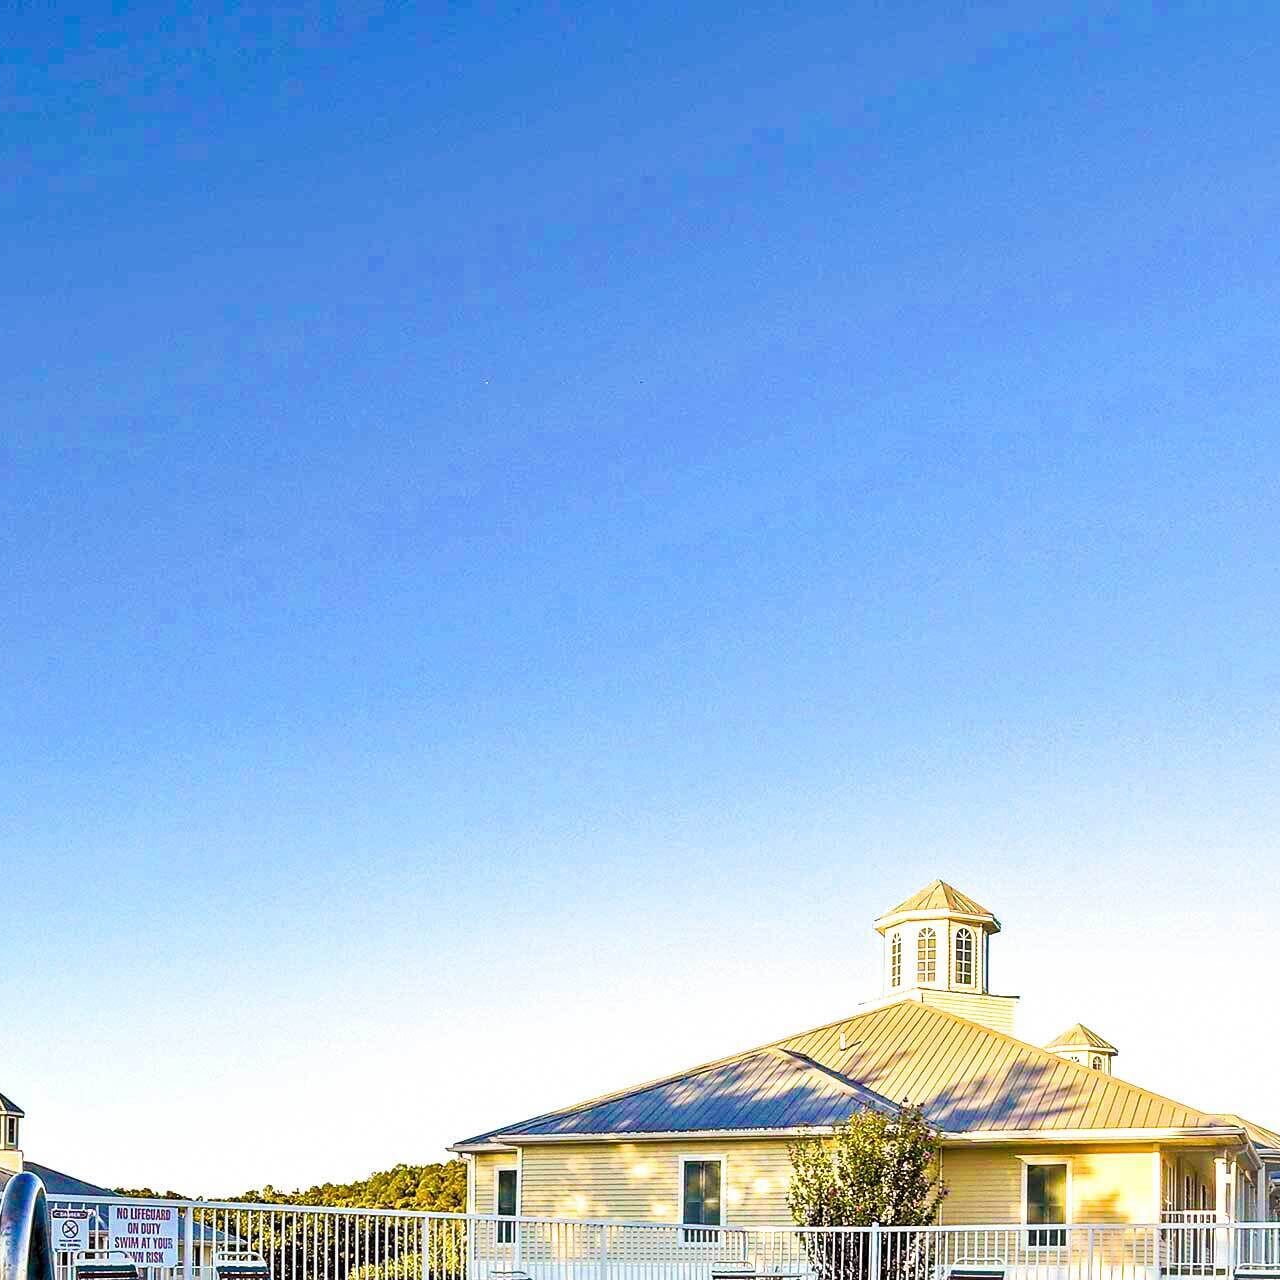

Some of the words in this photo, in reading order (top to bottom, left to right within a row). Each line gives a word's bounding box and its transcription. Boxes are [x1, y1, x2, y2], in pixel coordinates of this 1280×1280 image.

[117, 1208, 128, 1219] NO
[131, 1208, 170, 1220] LIFEGUARD
[128, 1223, 138, 1234] ON
[141, 1223, 160, 1234] DUTY
[115, 1237, 138, 1248] SWIM
[141, 1238, 150, 1248] AT
[153, 1238, 172, 1249] YOUR
[128, 1251, 143, 1263] WN
[146, 1252, 163, 1263] RISK
